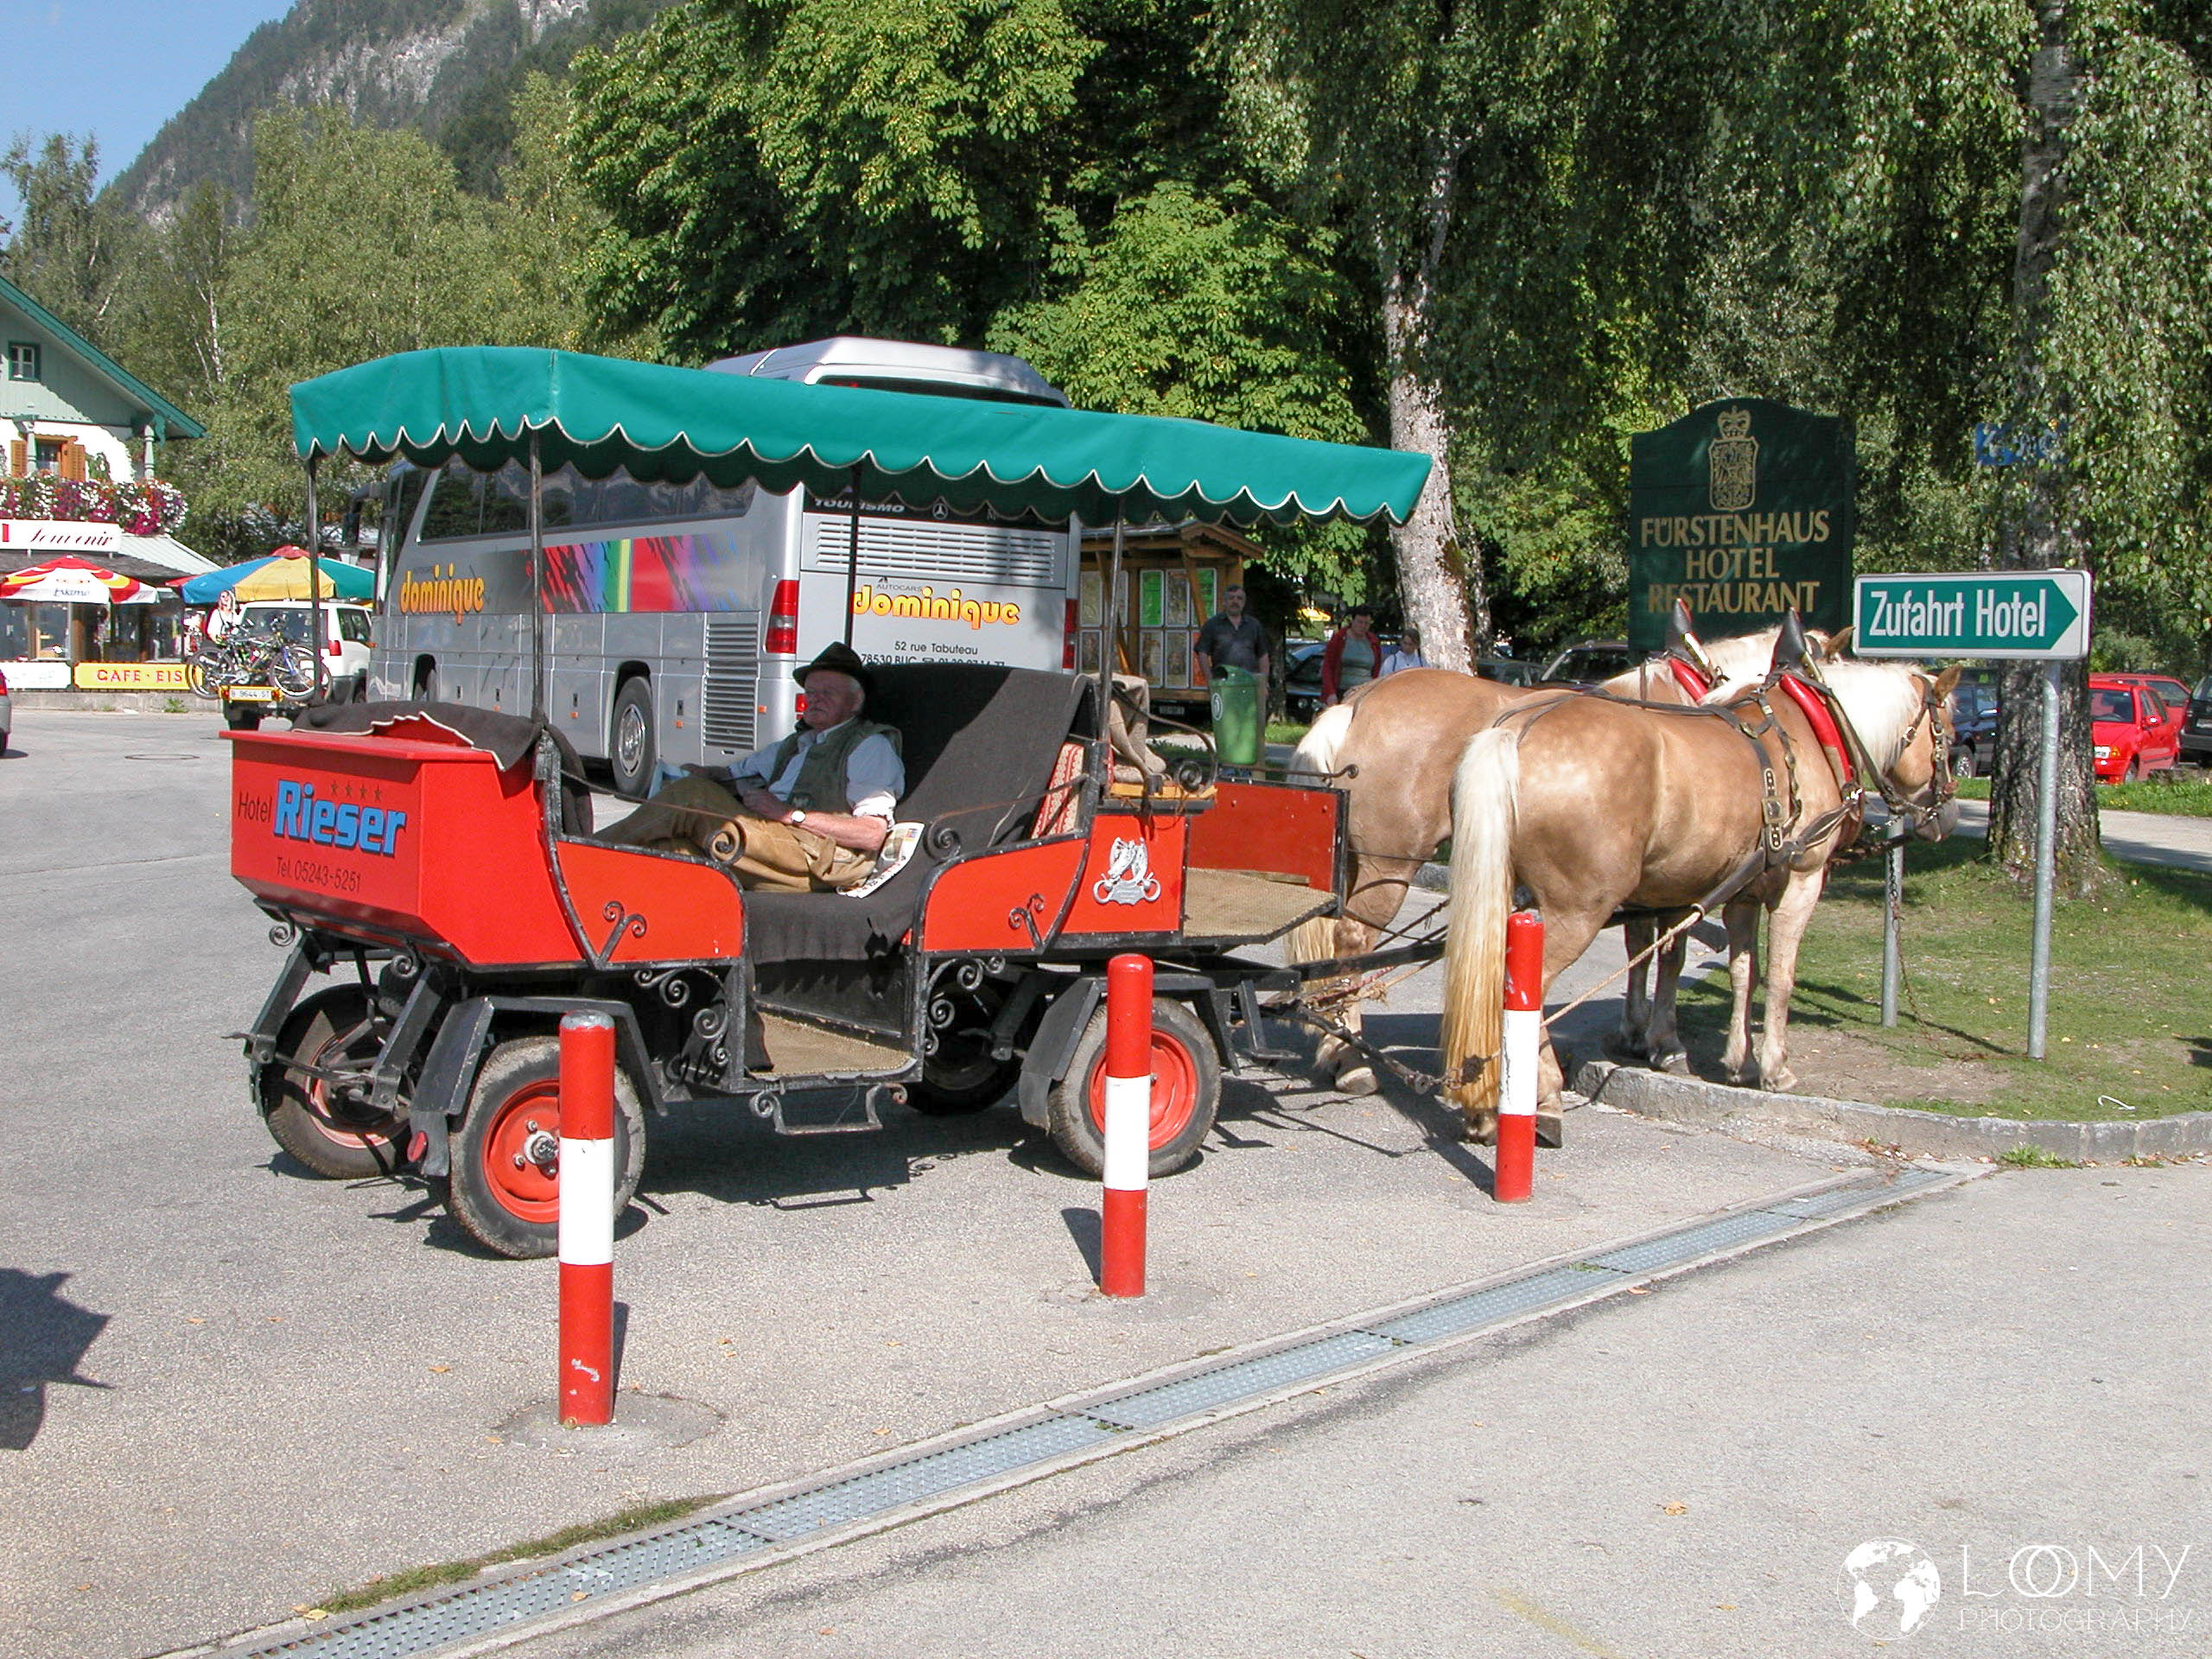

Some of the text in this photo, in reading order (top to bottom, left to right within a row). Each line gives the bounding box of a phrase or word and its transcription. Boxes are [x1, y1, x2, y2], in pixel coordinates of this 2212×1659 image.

[1641, 510, 1830, 548] FÜRSTENHAUS
[1686, 546, 1780, 581] HOTEL
[401, 563, 484, 626] dominique
[876, 583, 923, 593] AUTOCARS
[1647, 581, 1821, 613] RESTAURANT
[852, 584, 1020, 630] dominique
[1869, 588, 2046, 638] Zufahrt Hotel
[893, 641, 978, 656] 52 rue Tabuteau
[97, 669, 182, 682] CAFE EIS
[238, 779, 407, 857] Hotel Rieser
[295, 860, 361, 893] 05243-5251
